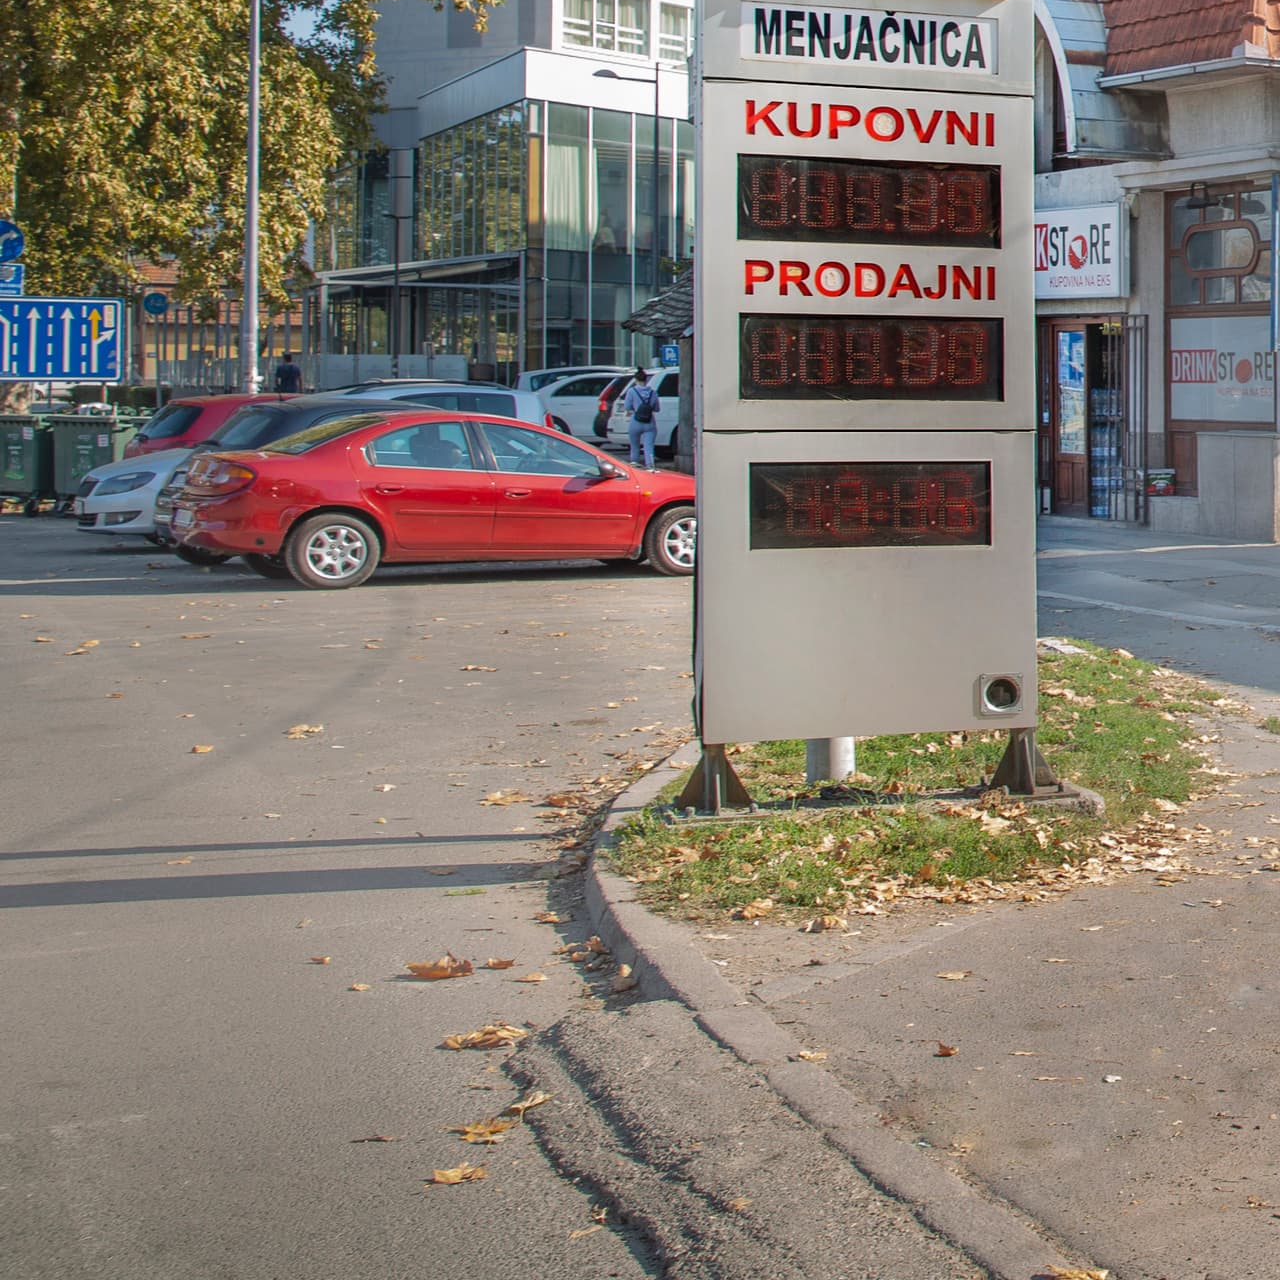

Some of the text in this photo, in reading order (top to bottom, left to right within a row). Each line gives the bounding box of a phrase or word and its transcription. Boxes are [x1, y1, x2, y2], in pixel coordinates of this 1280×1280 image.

[754, 7, 986, 69] MENJAČNICA
[745, 99, 995, 147] KUPOVNI
[744, 260, 996, 300] PRODAJNI
